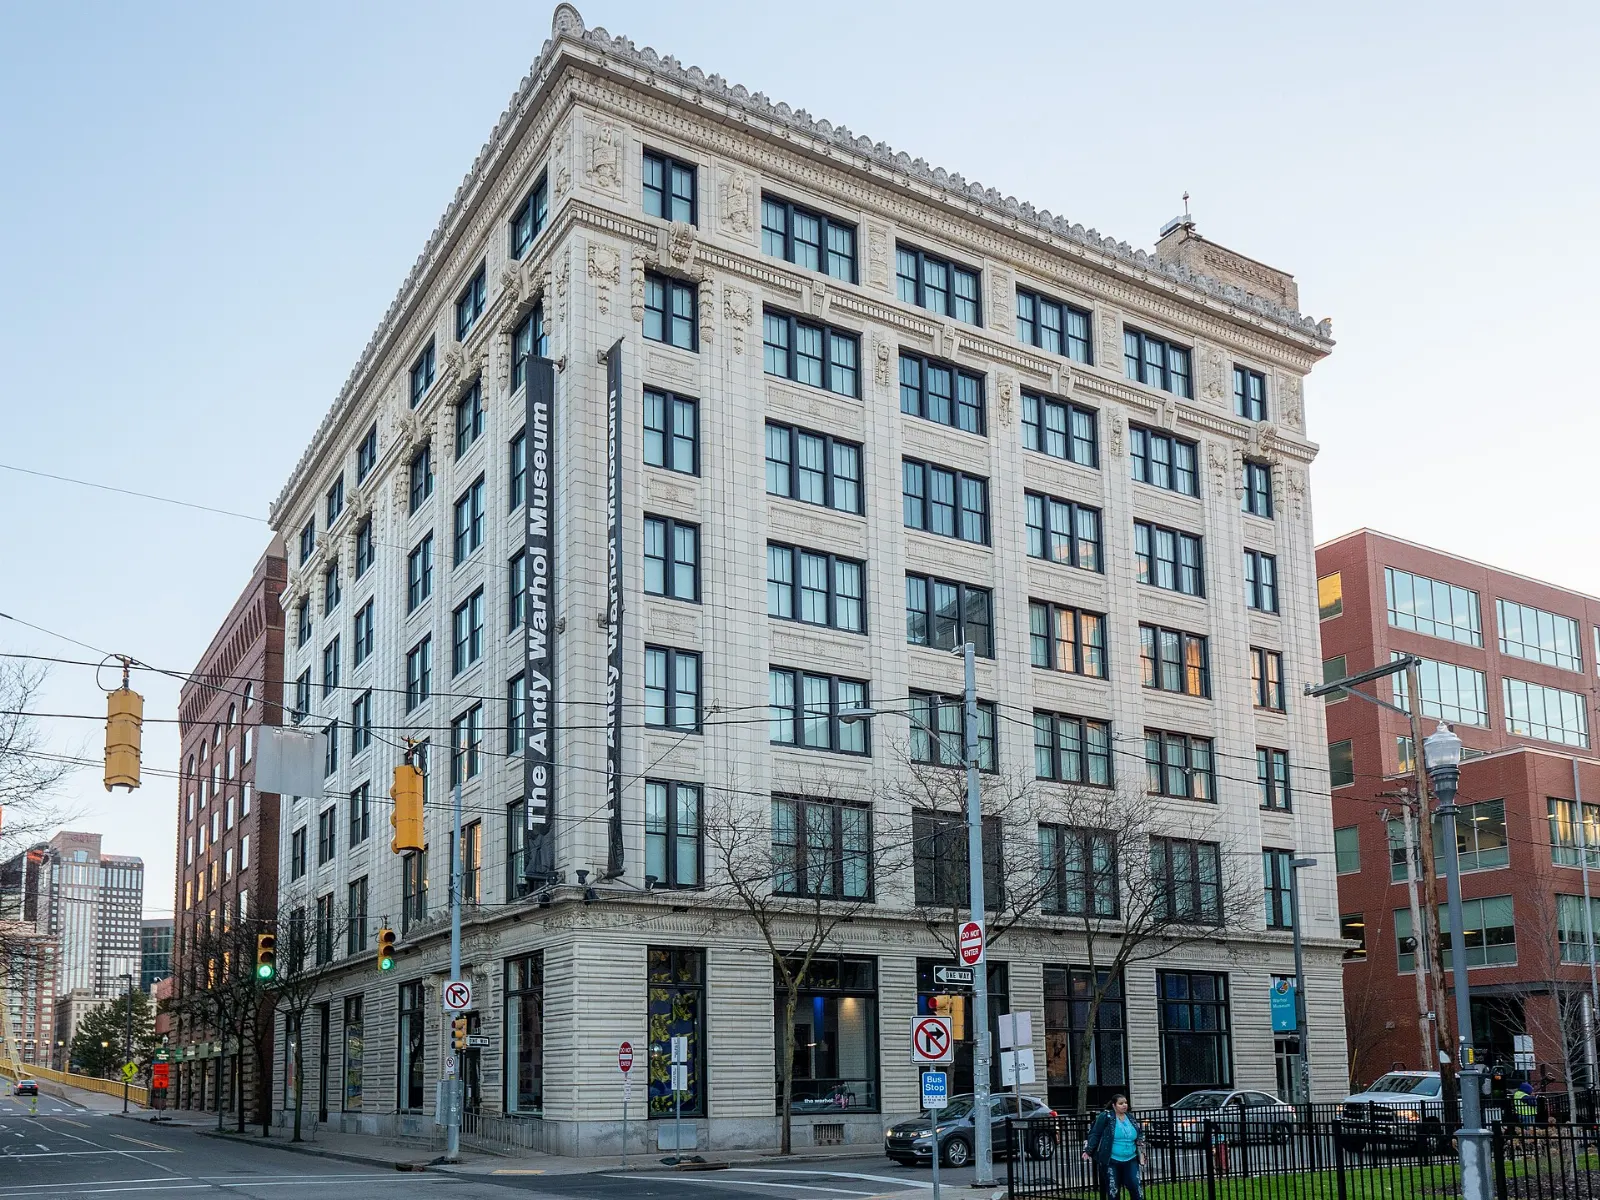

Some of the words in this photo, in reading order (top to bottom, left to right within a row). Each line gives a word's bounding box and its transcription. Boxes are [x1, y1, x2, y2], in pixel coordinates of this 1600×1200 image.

[529, 402, 547, 537] Museum
[529, 546, 548, 661] Warhol
[529, 669, 551, 756] Andy
[528, 765, 547, 830] The
[970, 929, 980, 937] NOT
[964, 948, 979, 957] ENTER
[946, 971, 957, 979] ONE
[959, 971, 970, 980] WAY
[926, 1075, 943, 1083] Bus
[925, 1083, 945, 1092] Stop
